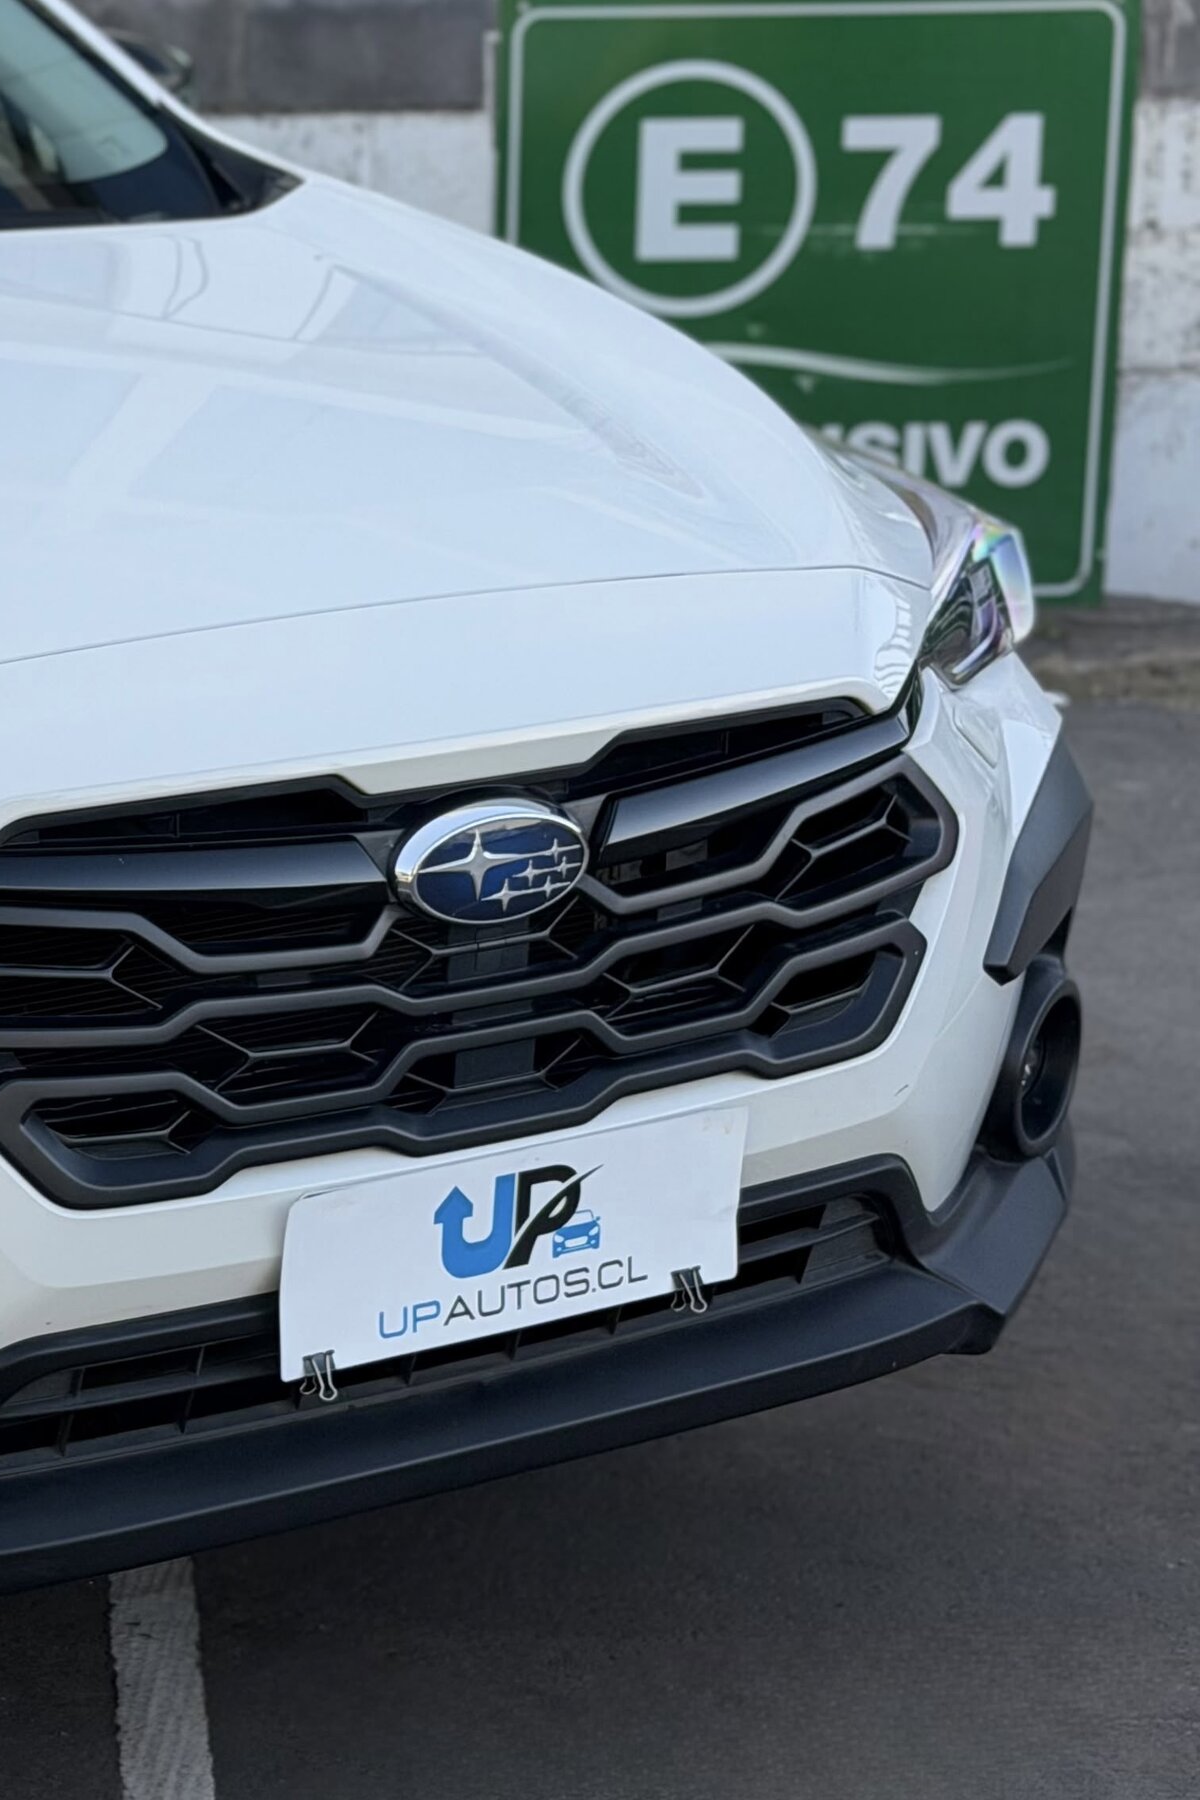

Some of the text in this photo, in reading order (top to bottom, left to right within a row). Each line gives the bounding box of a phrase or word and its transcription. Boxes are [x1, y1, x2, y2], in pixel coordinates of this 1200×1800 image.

[634, 112, 1056, 263] E 74
[433, 1163, 604, 1279] UP
[378, 1256, 648, 1339] UPAUTOS.CL
